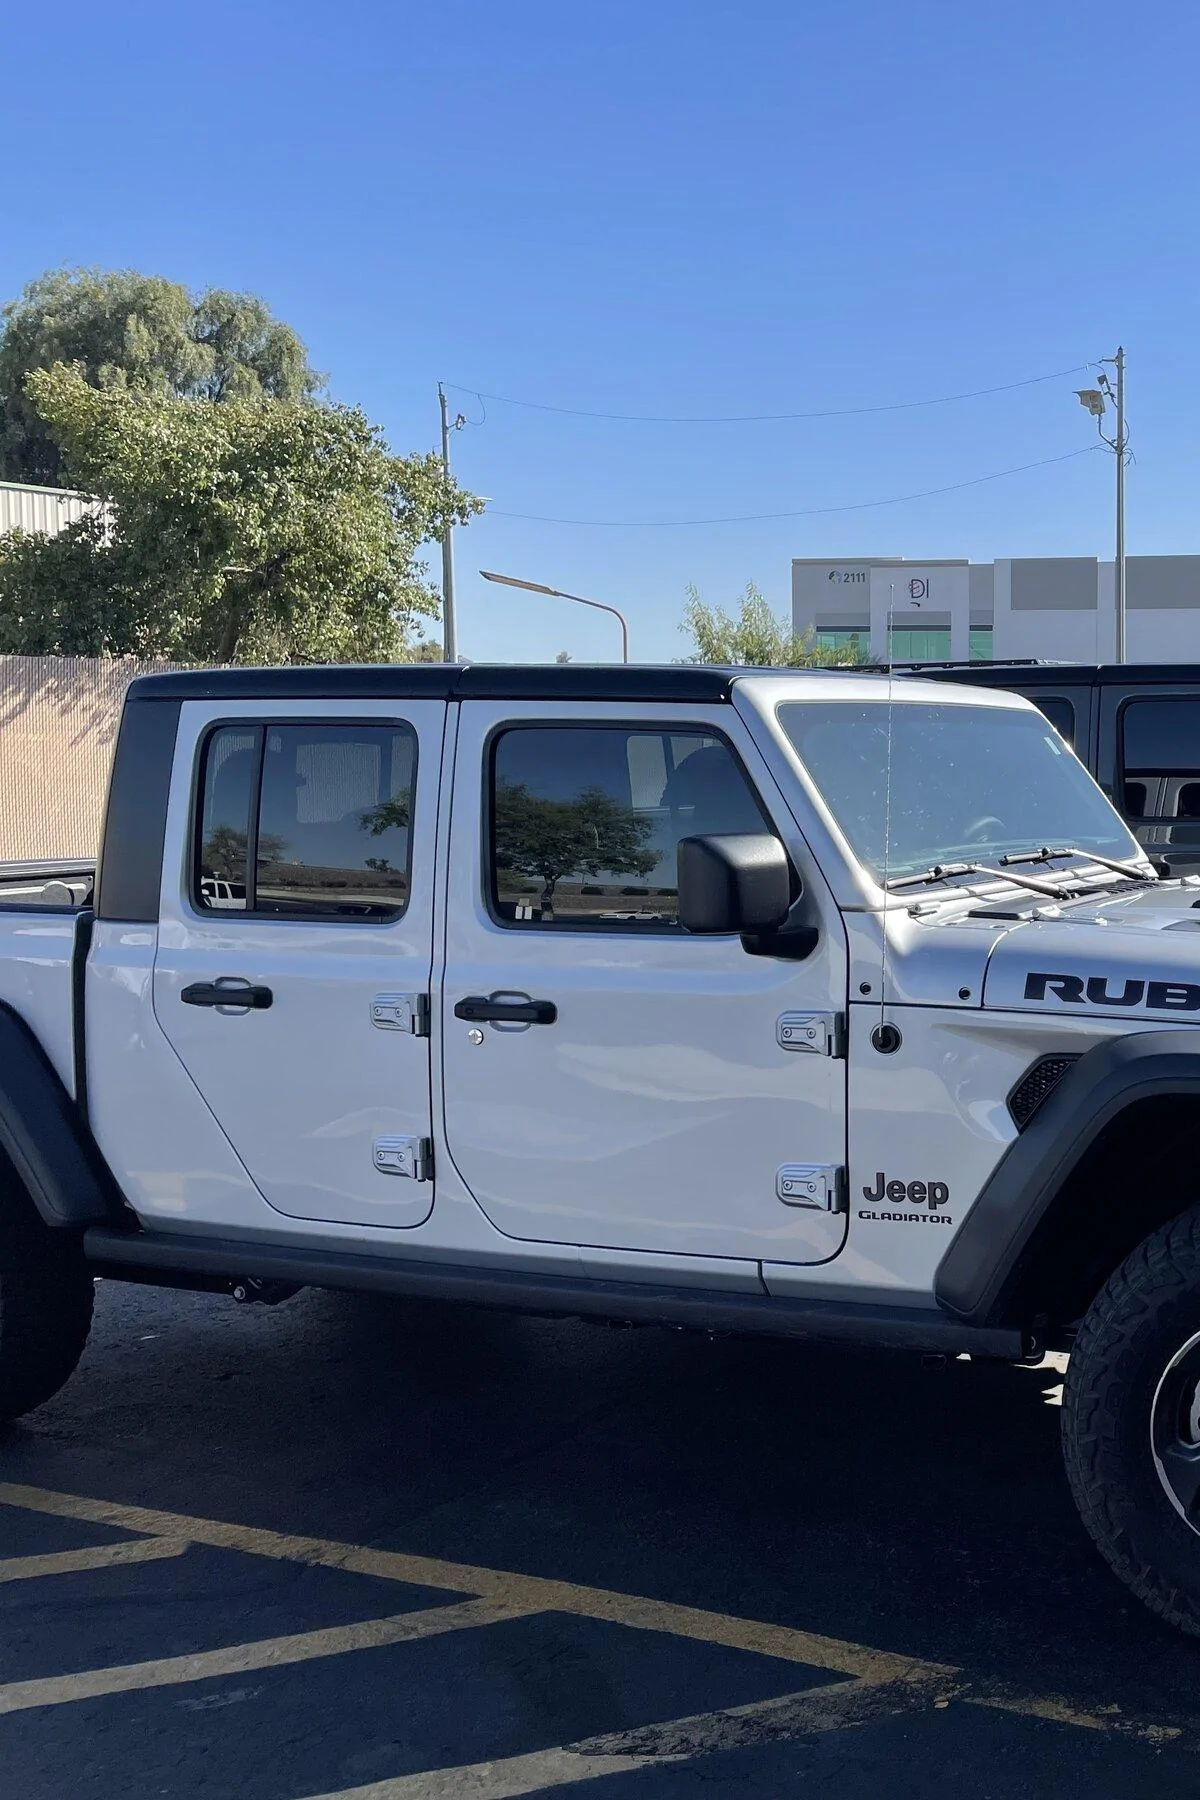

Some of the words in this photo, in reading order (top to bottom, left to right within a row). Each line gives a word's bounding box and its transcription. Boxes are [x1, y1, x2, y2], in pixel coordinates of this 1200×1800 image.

[843, 572, 866, 583] 2111
[862, 1172, 949, 1210] Jeep
[858, 1210, 952, 1225] GLADIATOR
